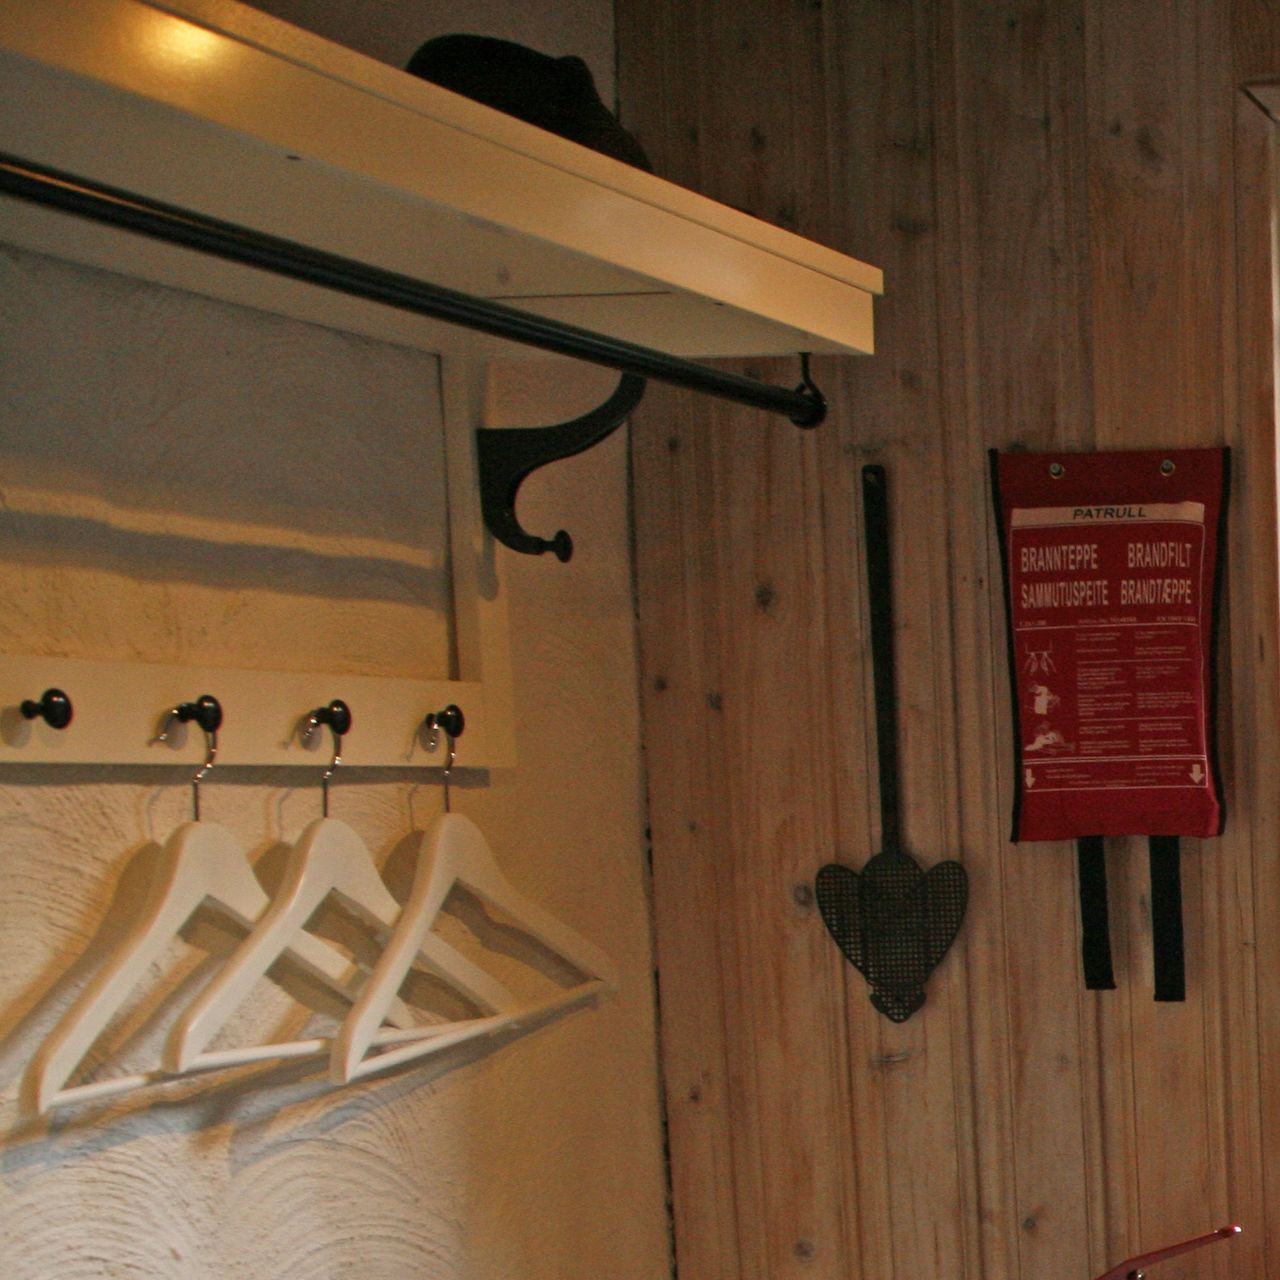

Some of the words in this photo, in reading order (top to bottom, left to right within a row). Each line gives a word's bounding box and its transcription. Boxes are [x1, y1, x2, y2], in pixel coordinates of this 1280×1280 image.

[1072, 507, 1147, 520] PATRULL
[1021, 544, 1098, 573] BRANNTEPPE
[1127, 542, 1192, 568] BRANDFILT
[1021, 580, 1109, 609] SAMMUTUSPEITE
[1121, 579, 1192, 605] BRANDTÆPPE
